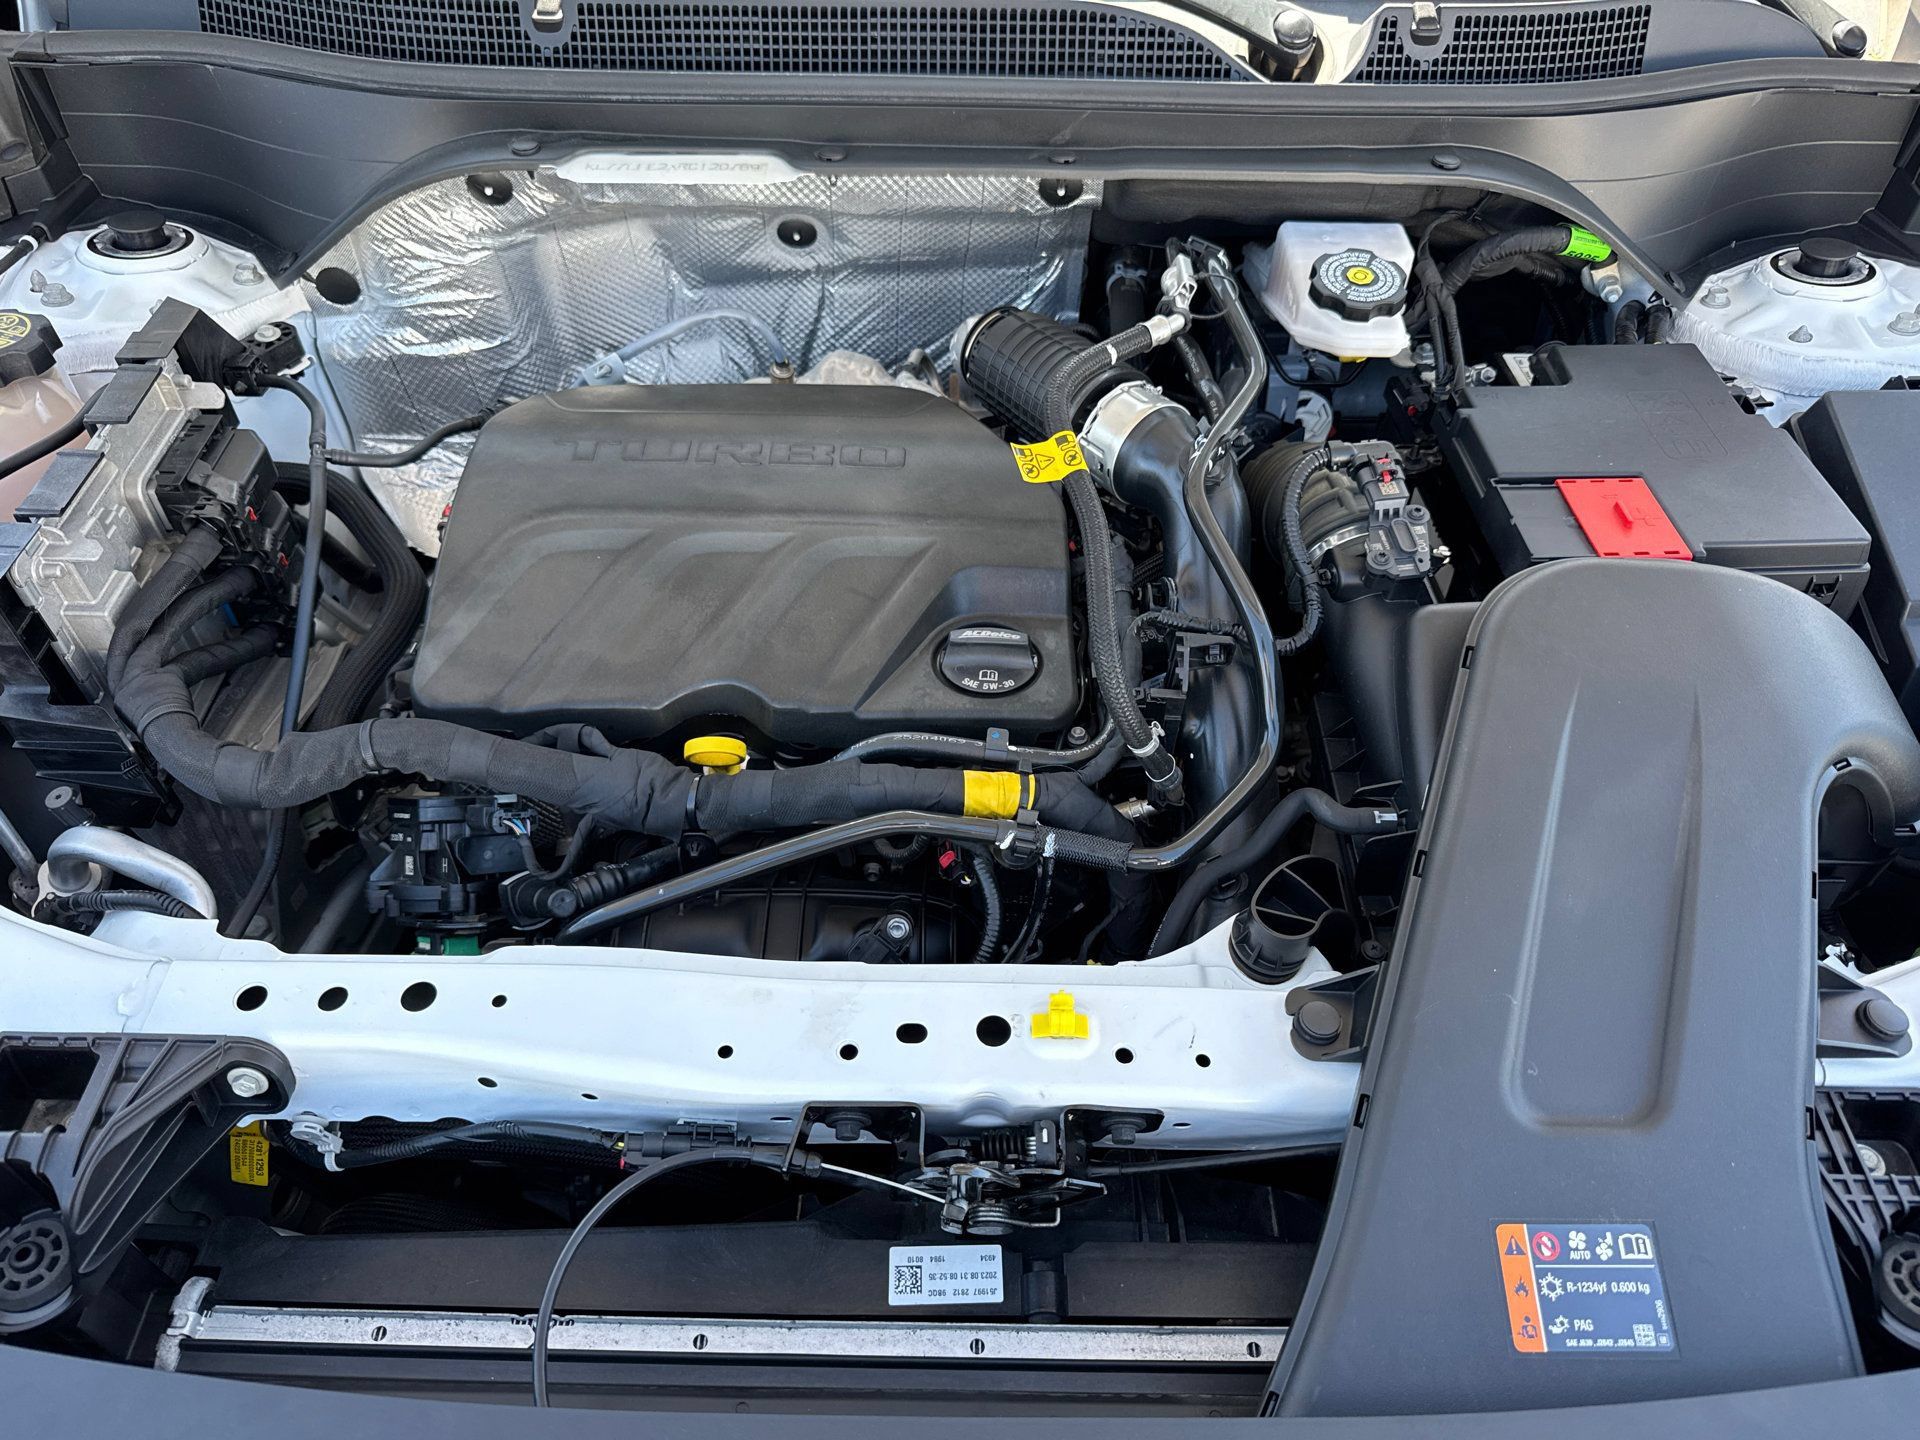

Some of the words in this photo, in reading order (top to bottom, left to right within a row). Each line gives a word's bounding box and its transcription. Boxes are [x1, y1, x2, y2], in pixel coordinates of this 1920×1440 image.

[554, 438, 907, 468] TURBO
[958, 630, 1021, 640] ACDelco
[962, 677, 980, 688] SAE
[982, 679, 1015, 690] 5W-30
[256, 1158, 264, 1176] 1293
[1569, 1250, 1591, 1260] AUTO
[974, 1288, 998, 1296] J51997
[1566, 1282, 1608, 1295] R-1234yf
[1611, 1282, 1636, 1293] 0.600
[1638, 1282, 1650, 1295] kg
[1574, 1319, 1594, 1331] PAG
